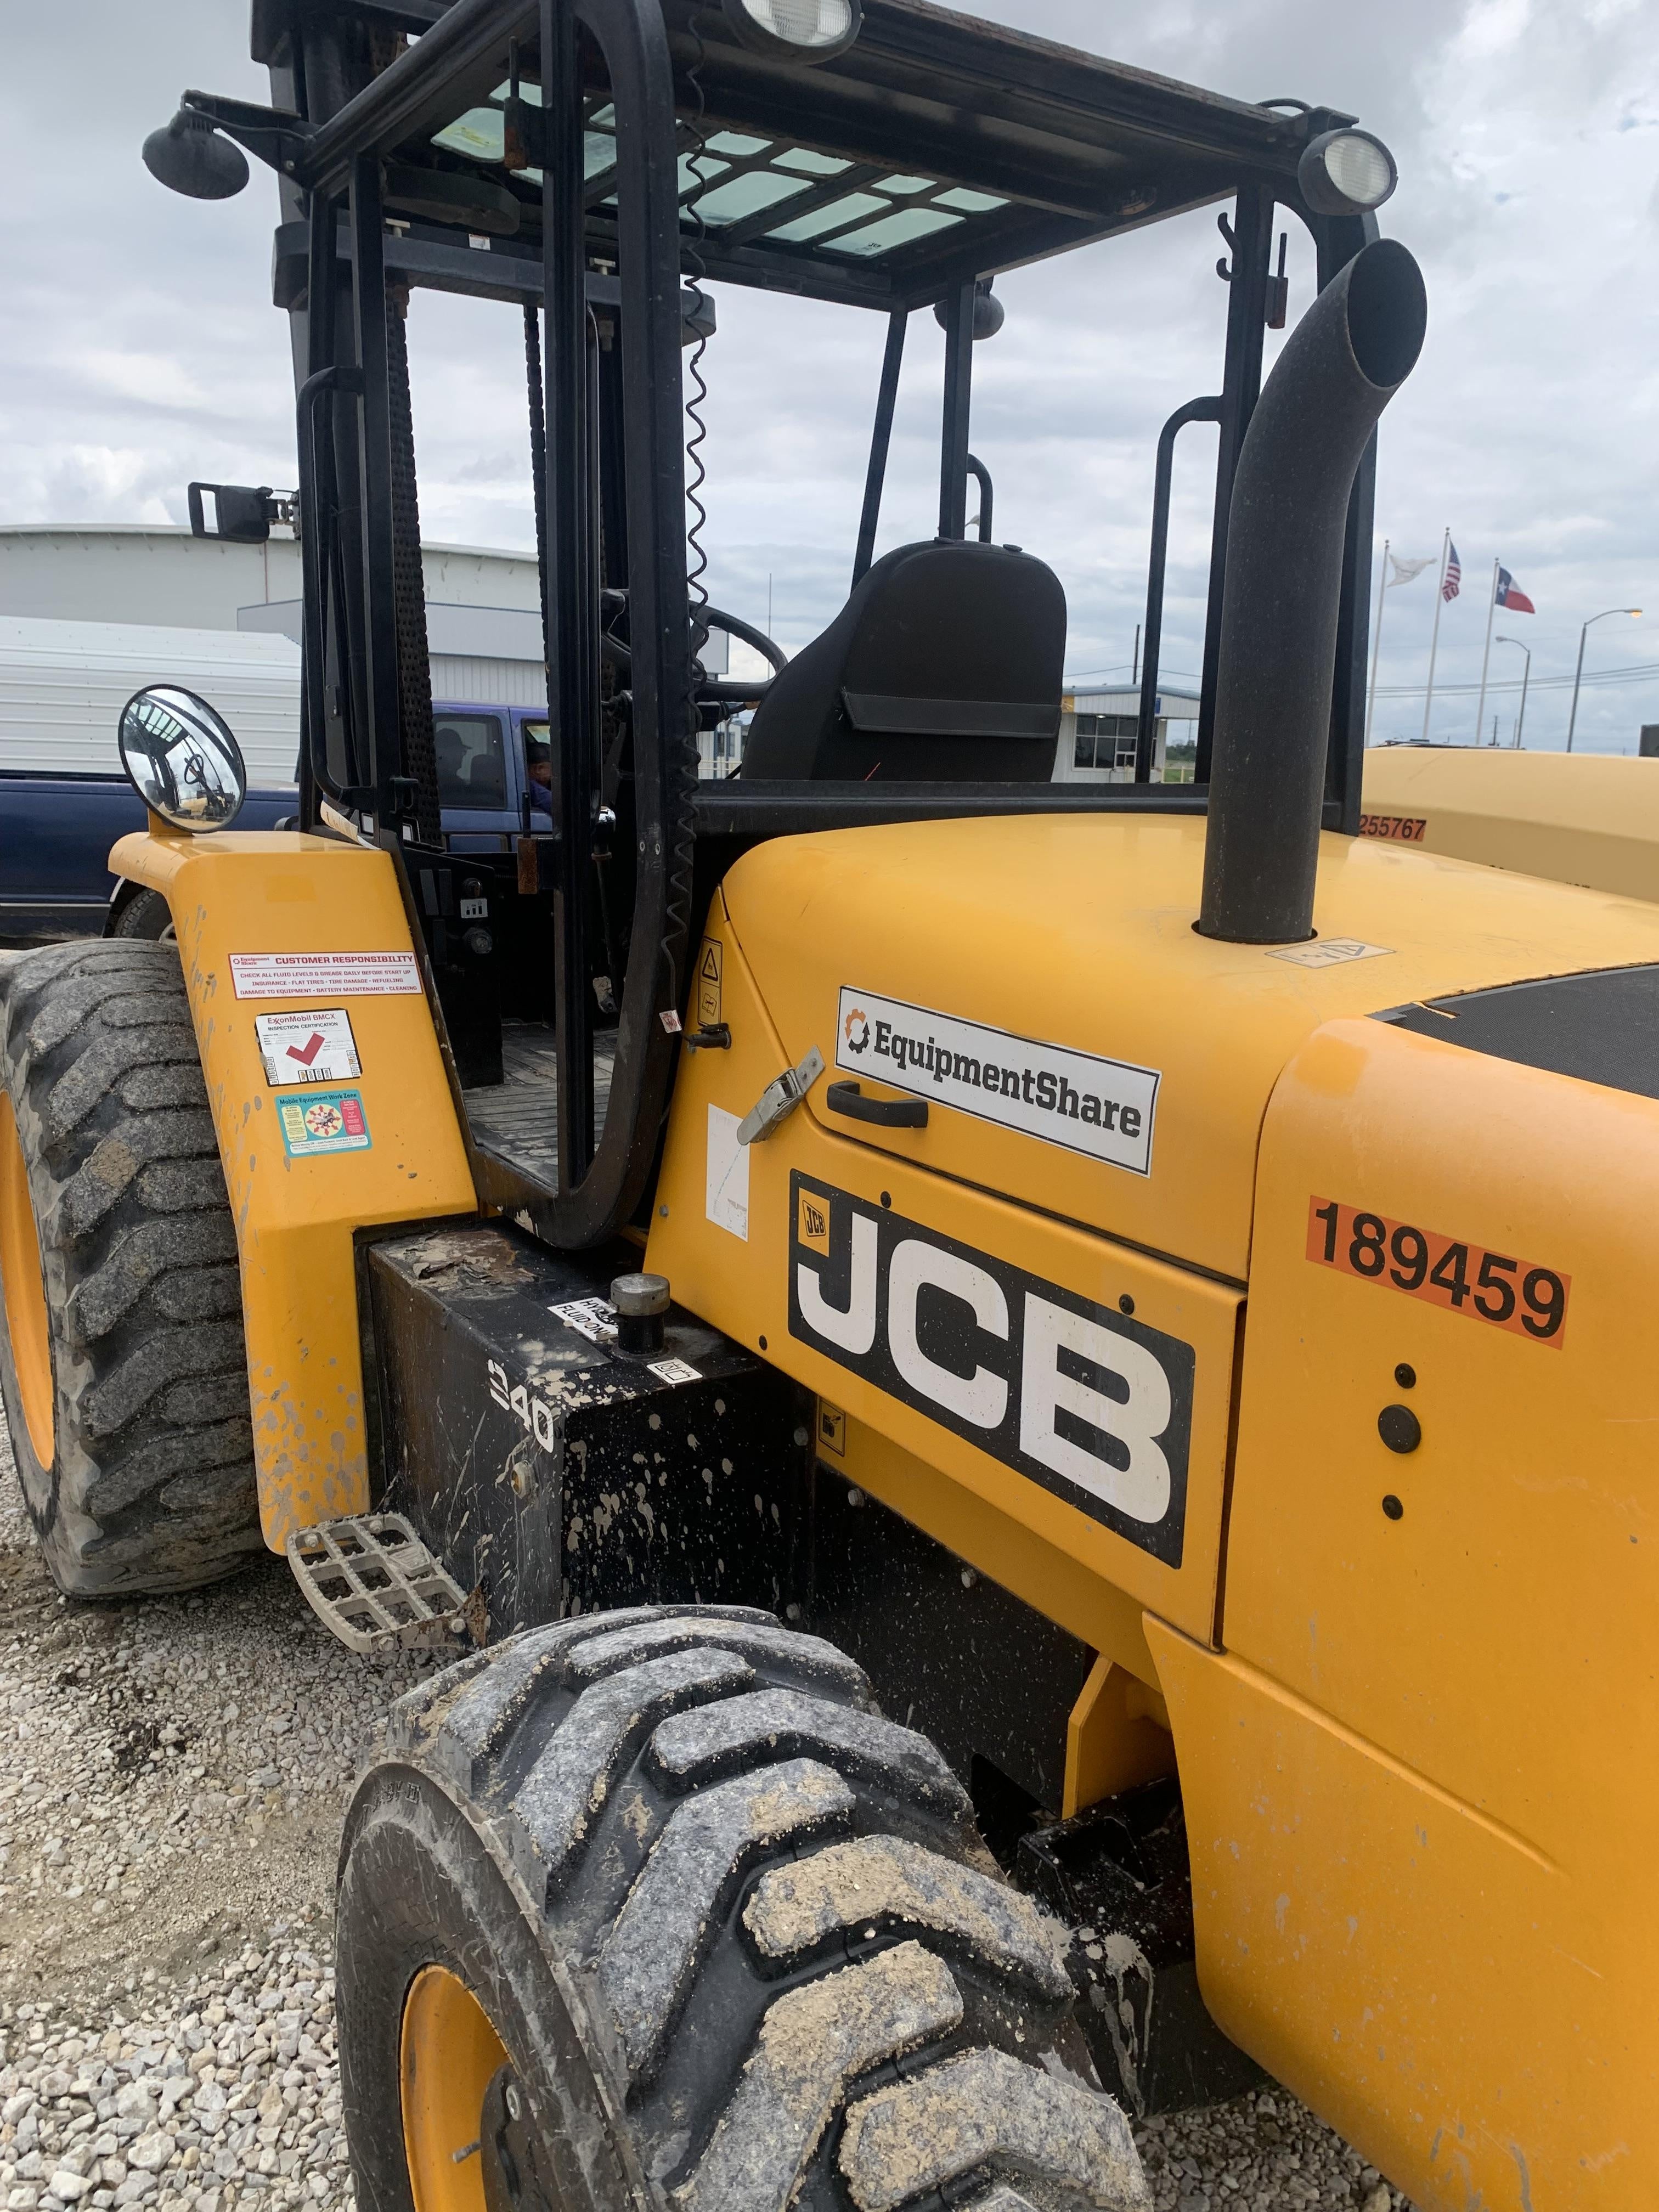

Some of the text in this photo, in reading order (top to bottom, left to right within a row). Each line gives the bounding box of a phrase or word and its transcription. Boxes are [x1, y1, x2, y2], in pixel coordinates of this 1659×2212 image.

[1360, 815, 1426, 839] 255767
[268, 1015, 312, 1025] ExxonMobil
[874, 1020, 1141, 1138] EquipmentShare
[806, 1205, 824, 1233] JCB
[1316, 1202, 1565, 1338] 189459
[557, 1305, 591, 1323] FLUID
[798, 1212, 1171, 1523] JCB
